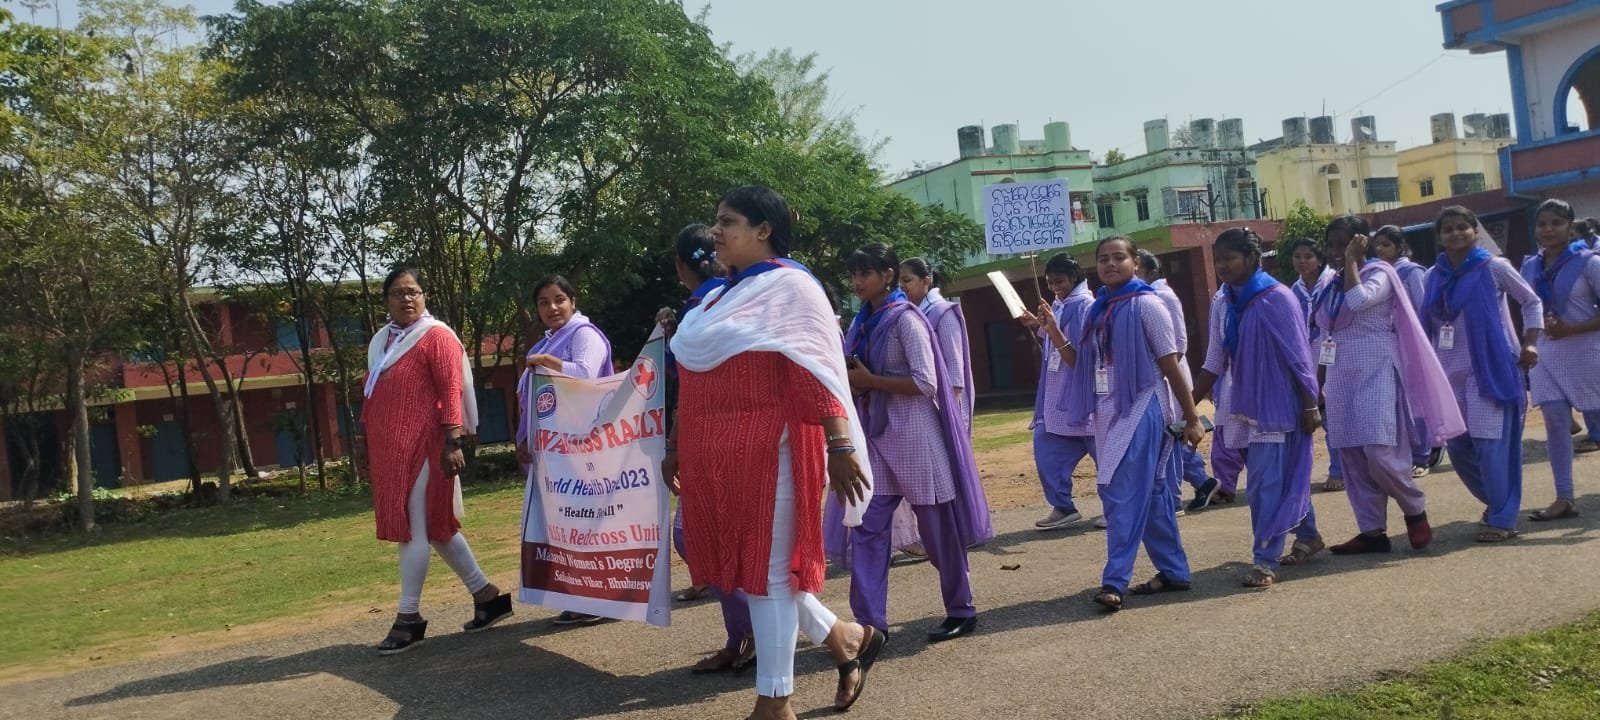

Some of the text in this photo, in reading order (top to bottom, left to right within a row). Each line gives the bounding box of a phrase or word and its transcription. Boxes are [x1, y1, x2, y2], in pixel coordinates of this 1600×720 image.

[602, 407, 664, 448] RALLY
[572, 478, 604, 496] Health
[569, 528, 628, 546] Redcross
[629, 524, 661, 542] Unit
[605, 555, 643, 572] Degree
